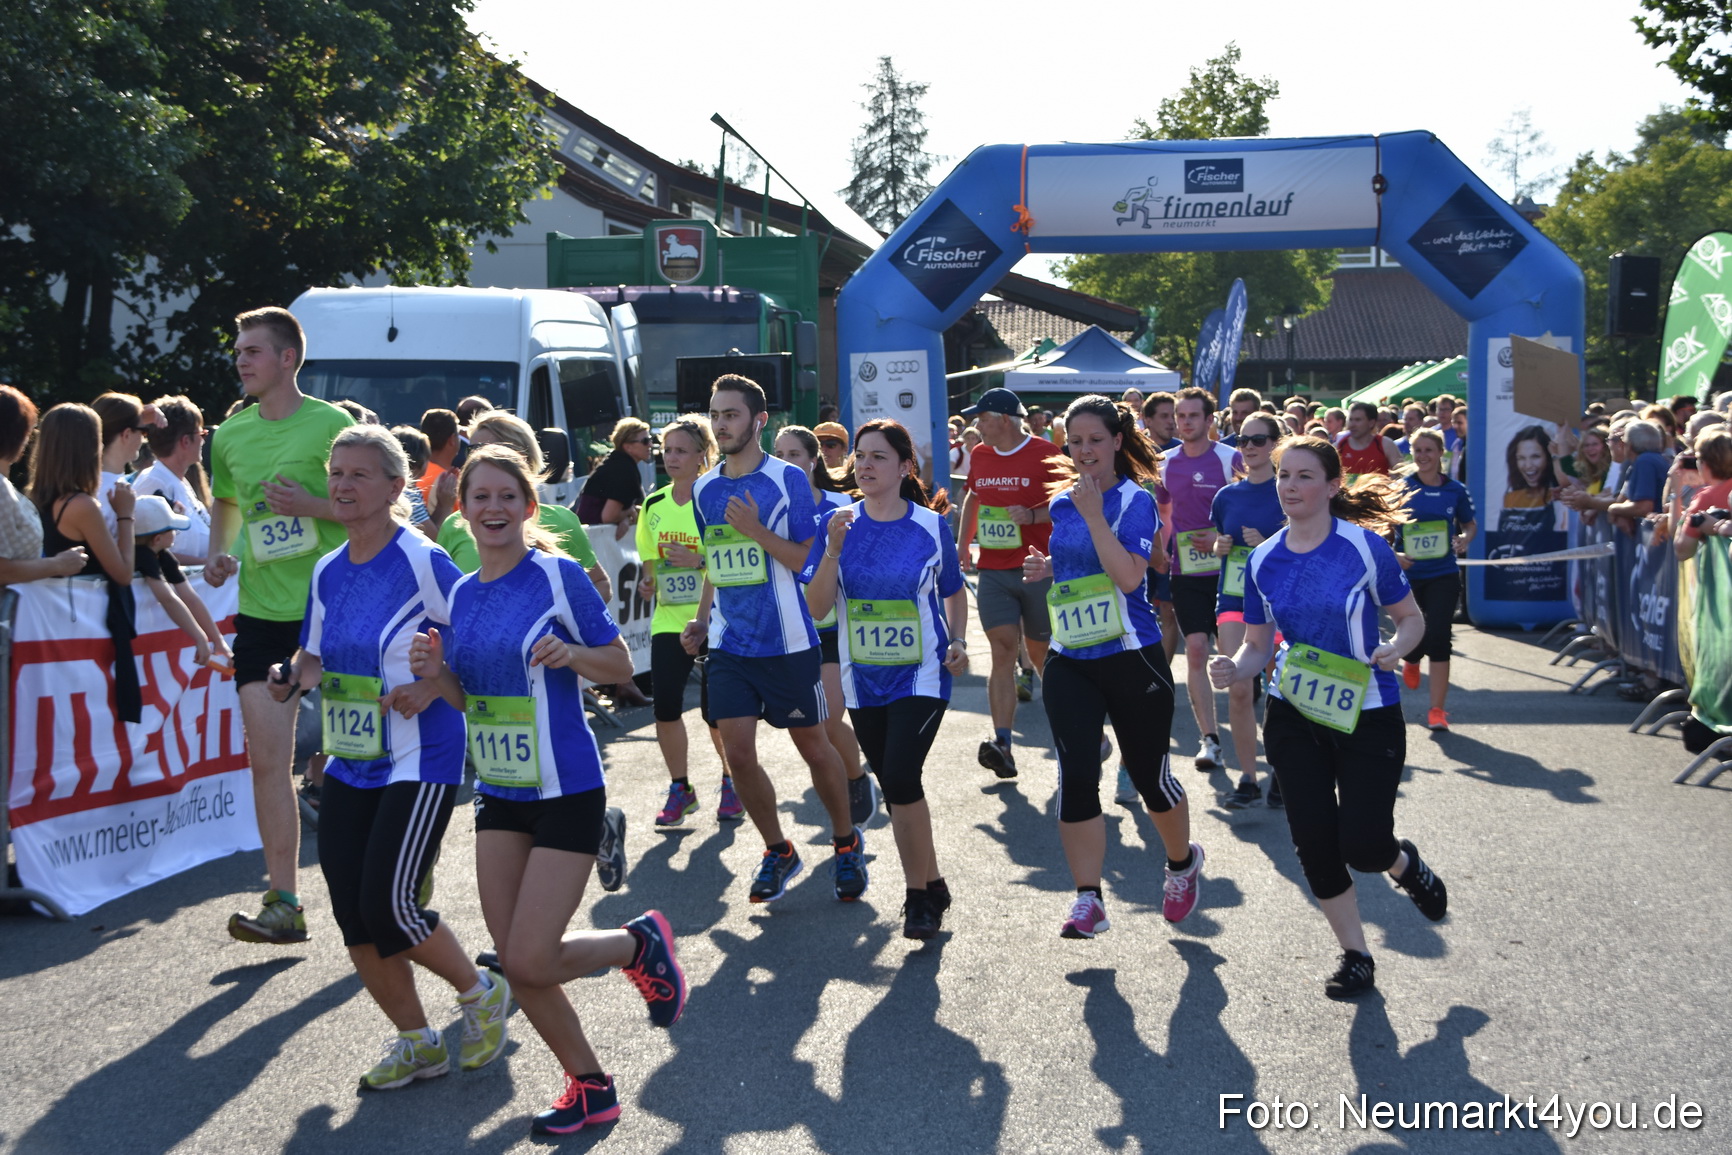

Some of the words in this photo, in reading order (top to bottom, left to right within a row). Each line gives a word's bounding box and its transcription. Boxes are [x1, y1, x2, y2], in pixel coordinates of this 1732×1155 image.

[1197, 172, 1240, 181] Fischer
[1163, 192, 1295, 218] firmenlauf
[1163, 220, 1217, 229] neumarkt
[917, 247, 987, 262] Fischer
[924, 261, 980, 269] AUTOMOBILE
[1664, 325, 1706, 377] AOK
[1038, 378, 1146, 386] www.fischer-automobile.de
[261, 516, 304, 546] 334
[658, 531, 699, 543] Müller
[980, 522, 1016, 538] 1402
[1412, 535, 1439, 550] 767
[712, 546, 760, 570] 1116
[666, 575, 696, 593] 339
[1058, 600, 1110, 631] 1117
[856, 626, 915, 647] 1126
[1290, 673, 1355, 711] 1118
[327, 706, 375, 738] 1124
[475, 730, 531, 762] 1115
